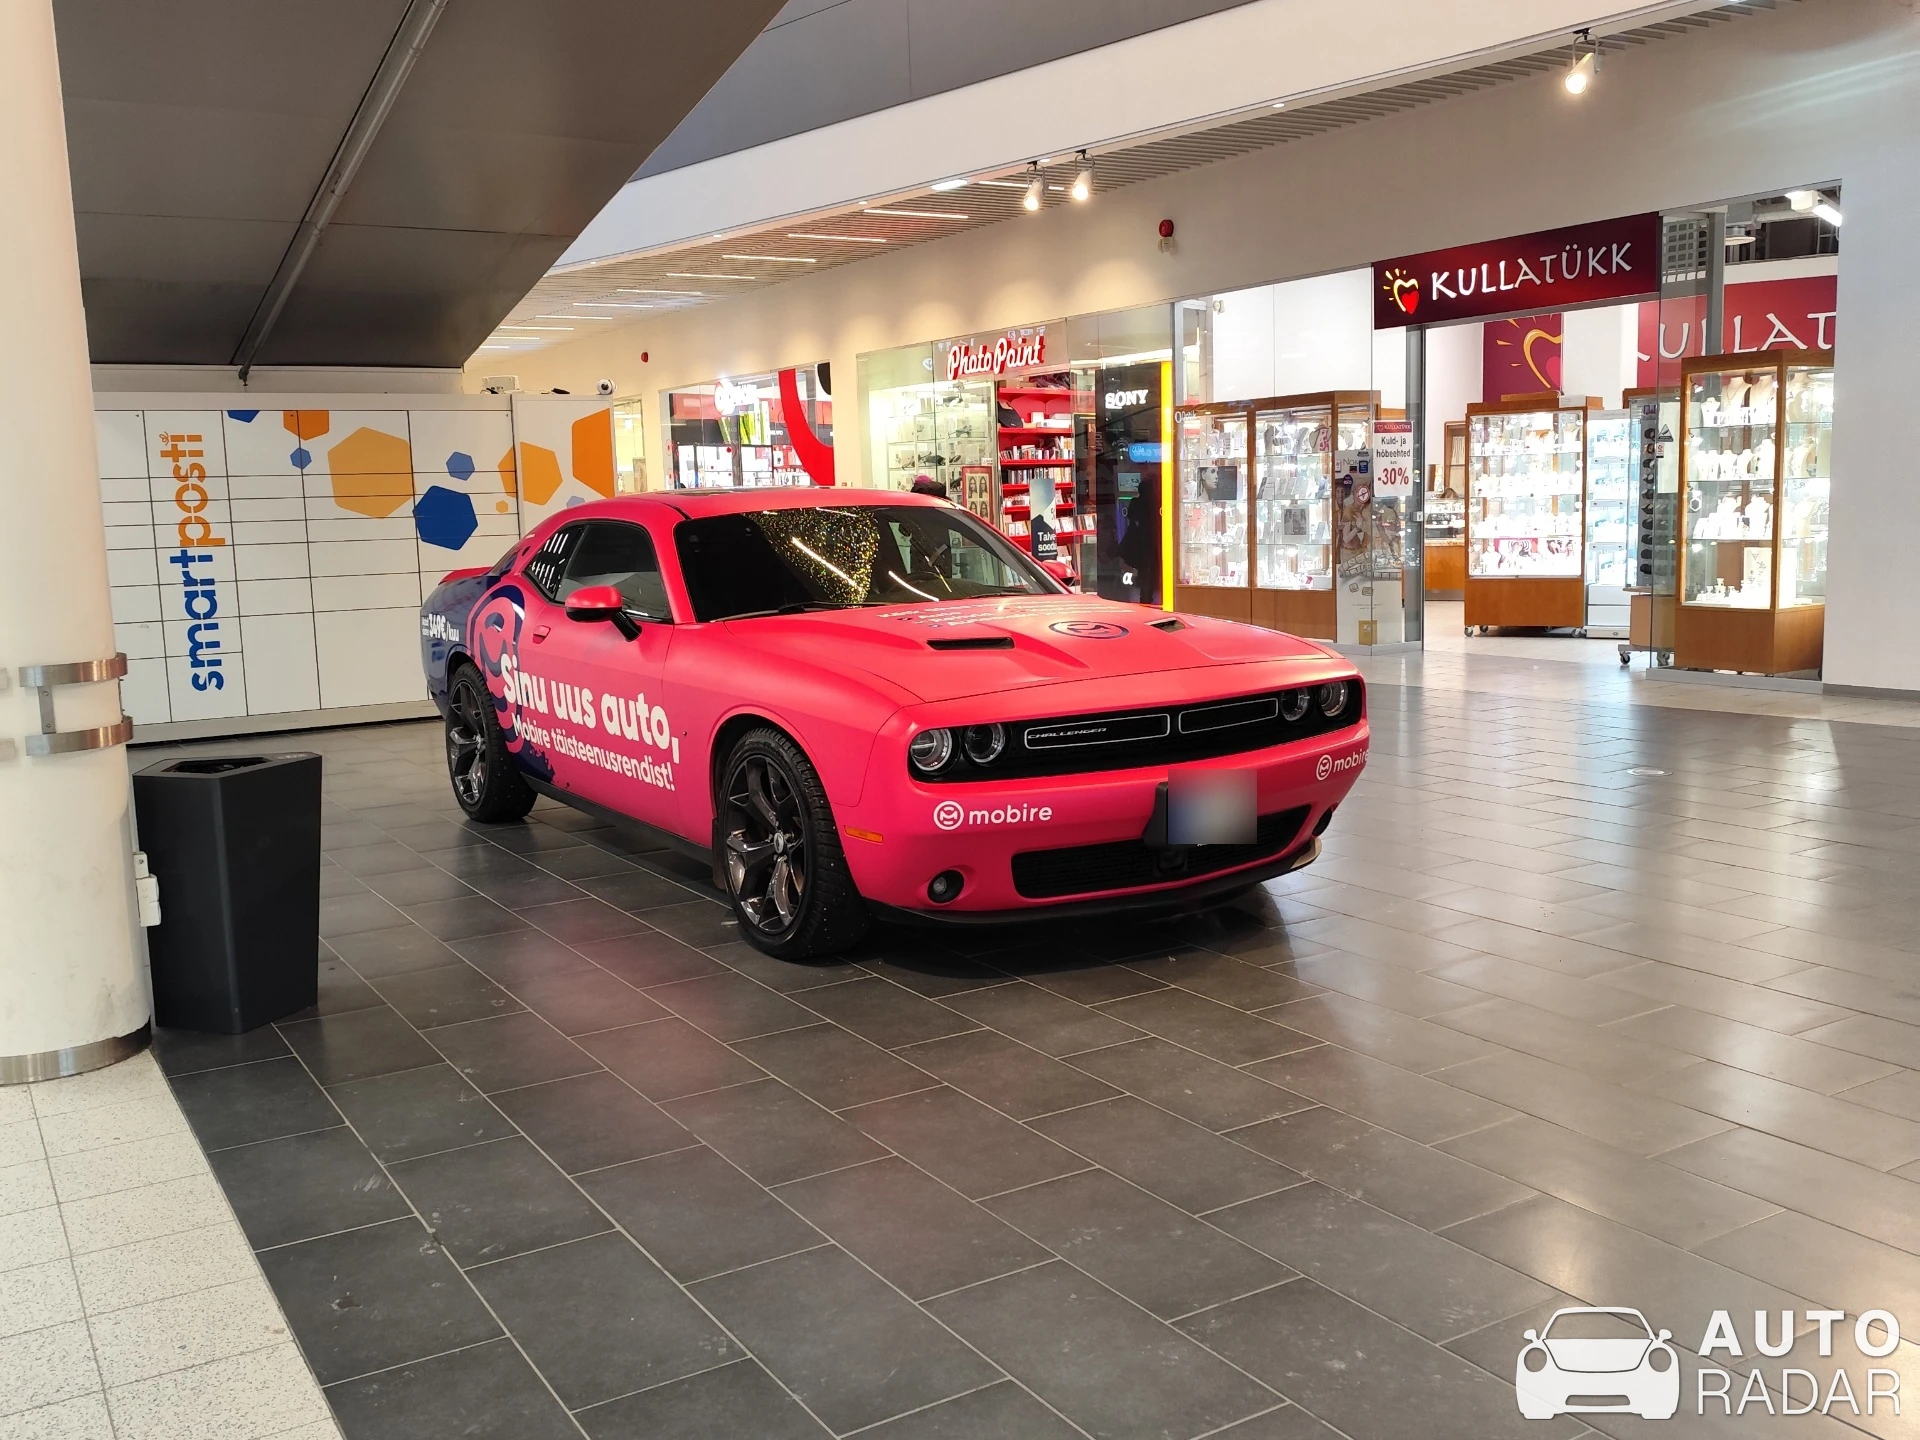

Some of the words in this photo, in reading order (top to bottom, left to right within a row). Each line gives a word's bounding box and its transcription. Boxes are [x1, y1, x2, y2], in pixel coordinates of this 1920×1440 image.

[1430, 241, 1633, 301] KULLATÜKK
[1105, 389, 1149, 409] SONY
[1400, 436, 1406, 446] ja
[1377, 467, 1409, 485] -30%
[159, 431, 226, 692] smartposti
[500, 653, 549, 715] Sinu
[550, 680, 597, 729] uus
[600, 692, 680, 765] auto,
[1027, 727, 1107, 739] CHALLENGER
[511, 713, 551, 749] Mobire
[550, 728, 676, 792] täisteenusrendist!
[968, 803, 1053, 825] mobire
